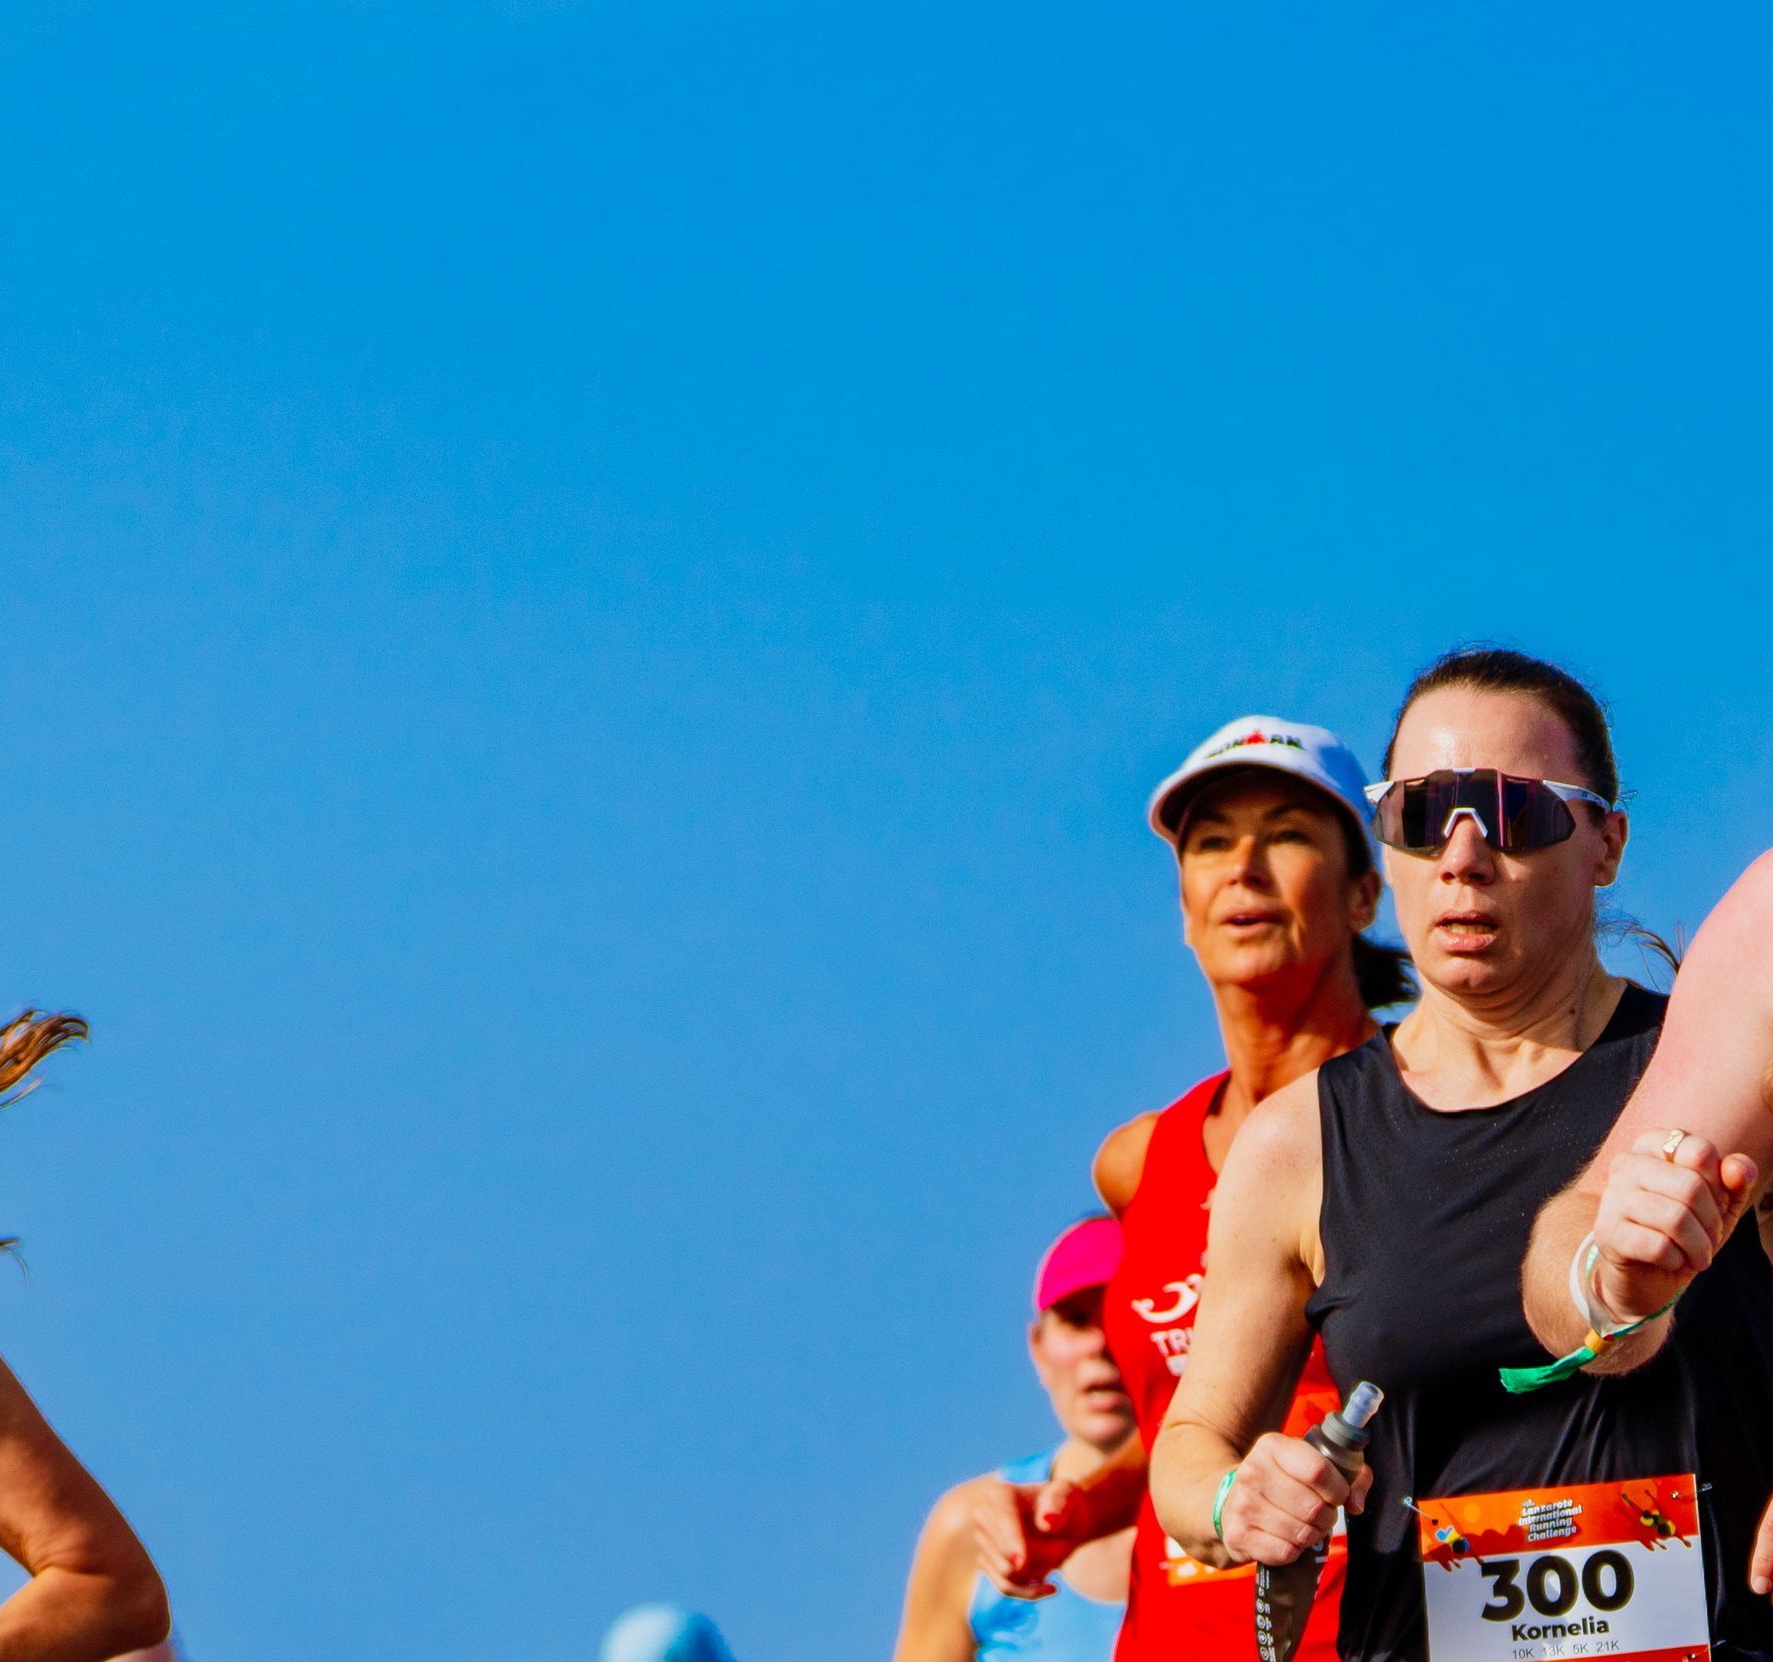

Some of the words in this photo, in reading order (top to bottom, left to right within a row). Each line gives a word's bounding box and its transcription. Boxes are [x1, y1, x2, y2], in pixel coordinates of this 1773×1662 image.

[1517, 1504, 1583, 1526] International
[1522, 1499, 1573, 1517] Lanzarote
[1527, 1526, 1577, 1542] Challenge
[1529, 1517, 1573, 1532] Running
[1480, 1549, 1635, 1622] 300
[1511, 1615, 1610, 1642] Kornelia
[1512, 1647, 1535, 1660] 10K
[1542, 1645, 1565, 1658] 13K
[1572, 1643, 1589, 1655] 5K
[1596, 1639, 1620, 1653] 21K
